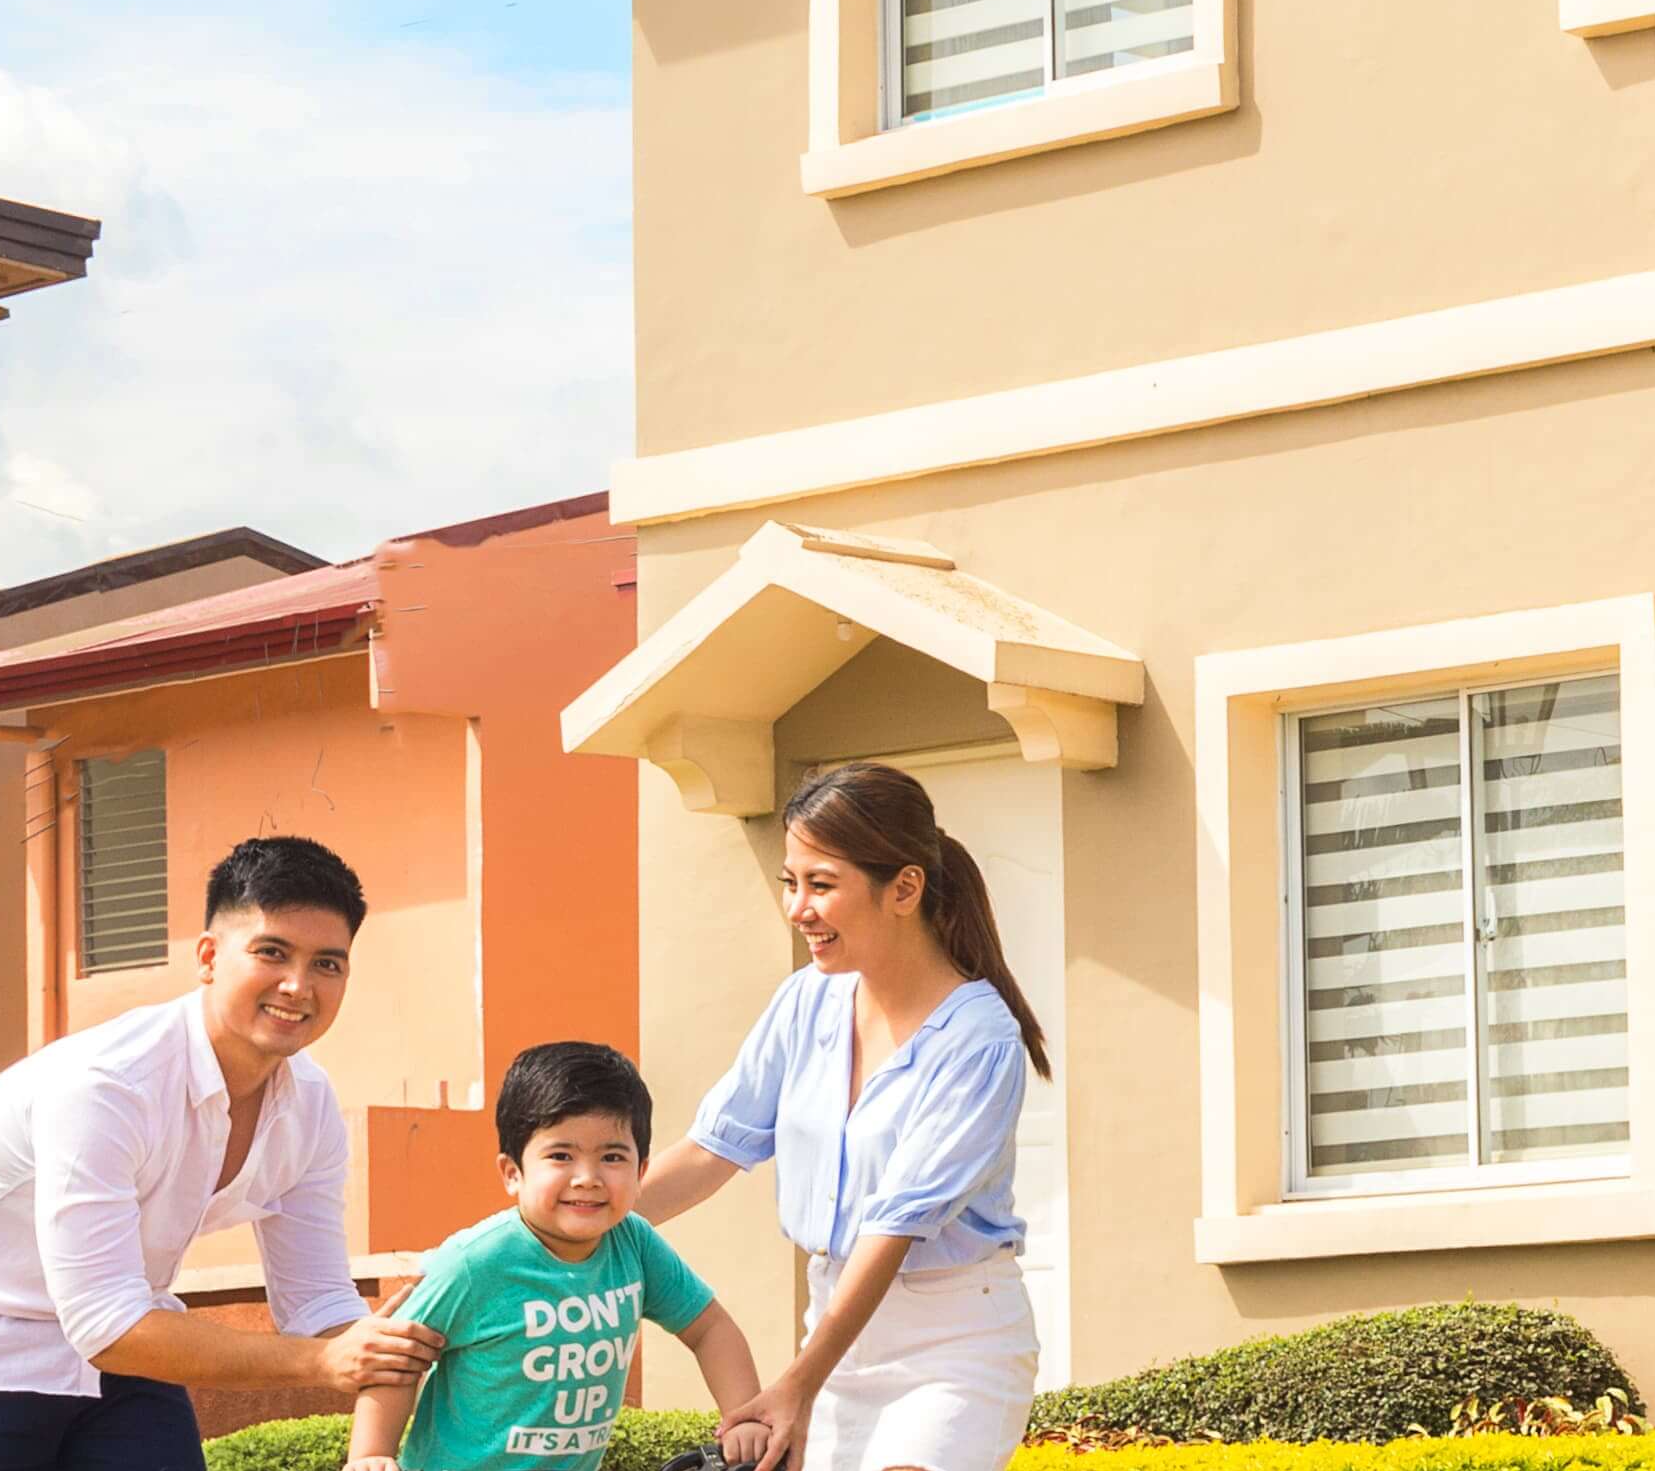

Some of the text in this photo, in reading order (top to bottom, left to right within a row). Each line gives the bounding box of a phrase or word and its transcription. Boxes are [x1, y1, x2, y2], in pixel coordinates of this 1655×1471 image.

[523, 1281, 642, 1339] DON'T
[554, 1384, 614, 1425] UP.
[512, 1425, 610, 1450] IT'S A TR
